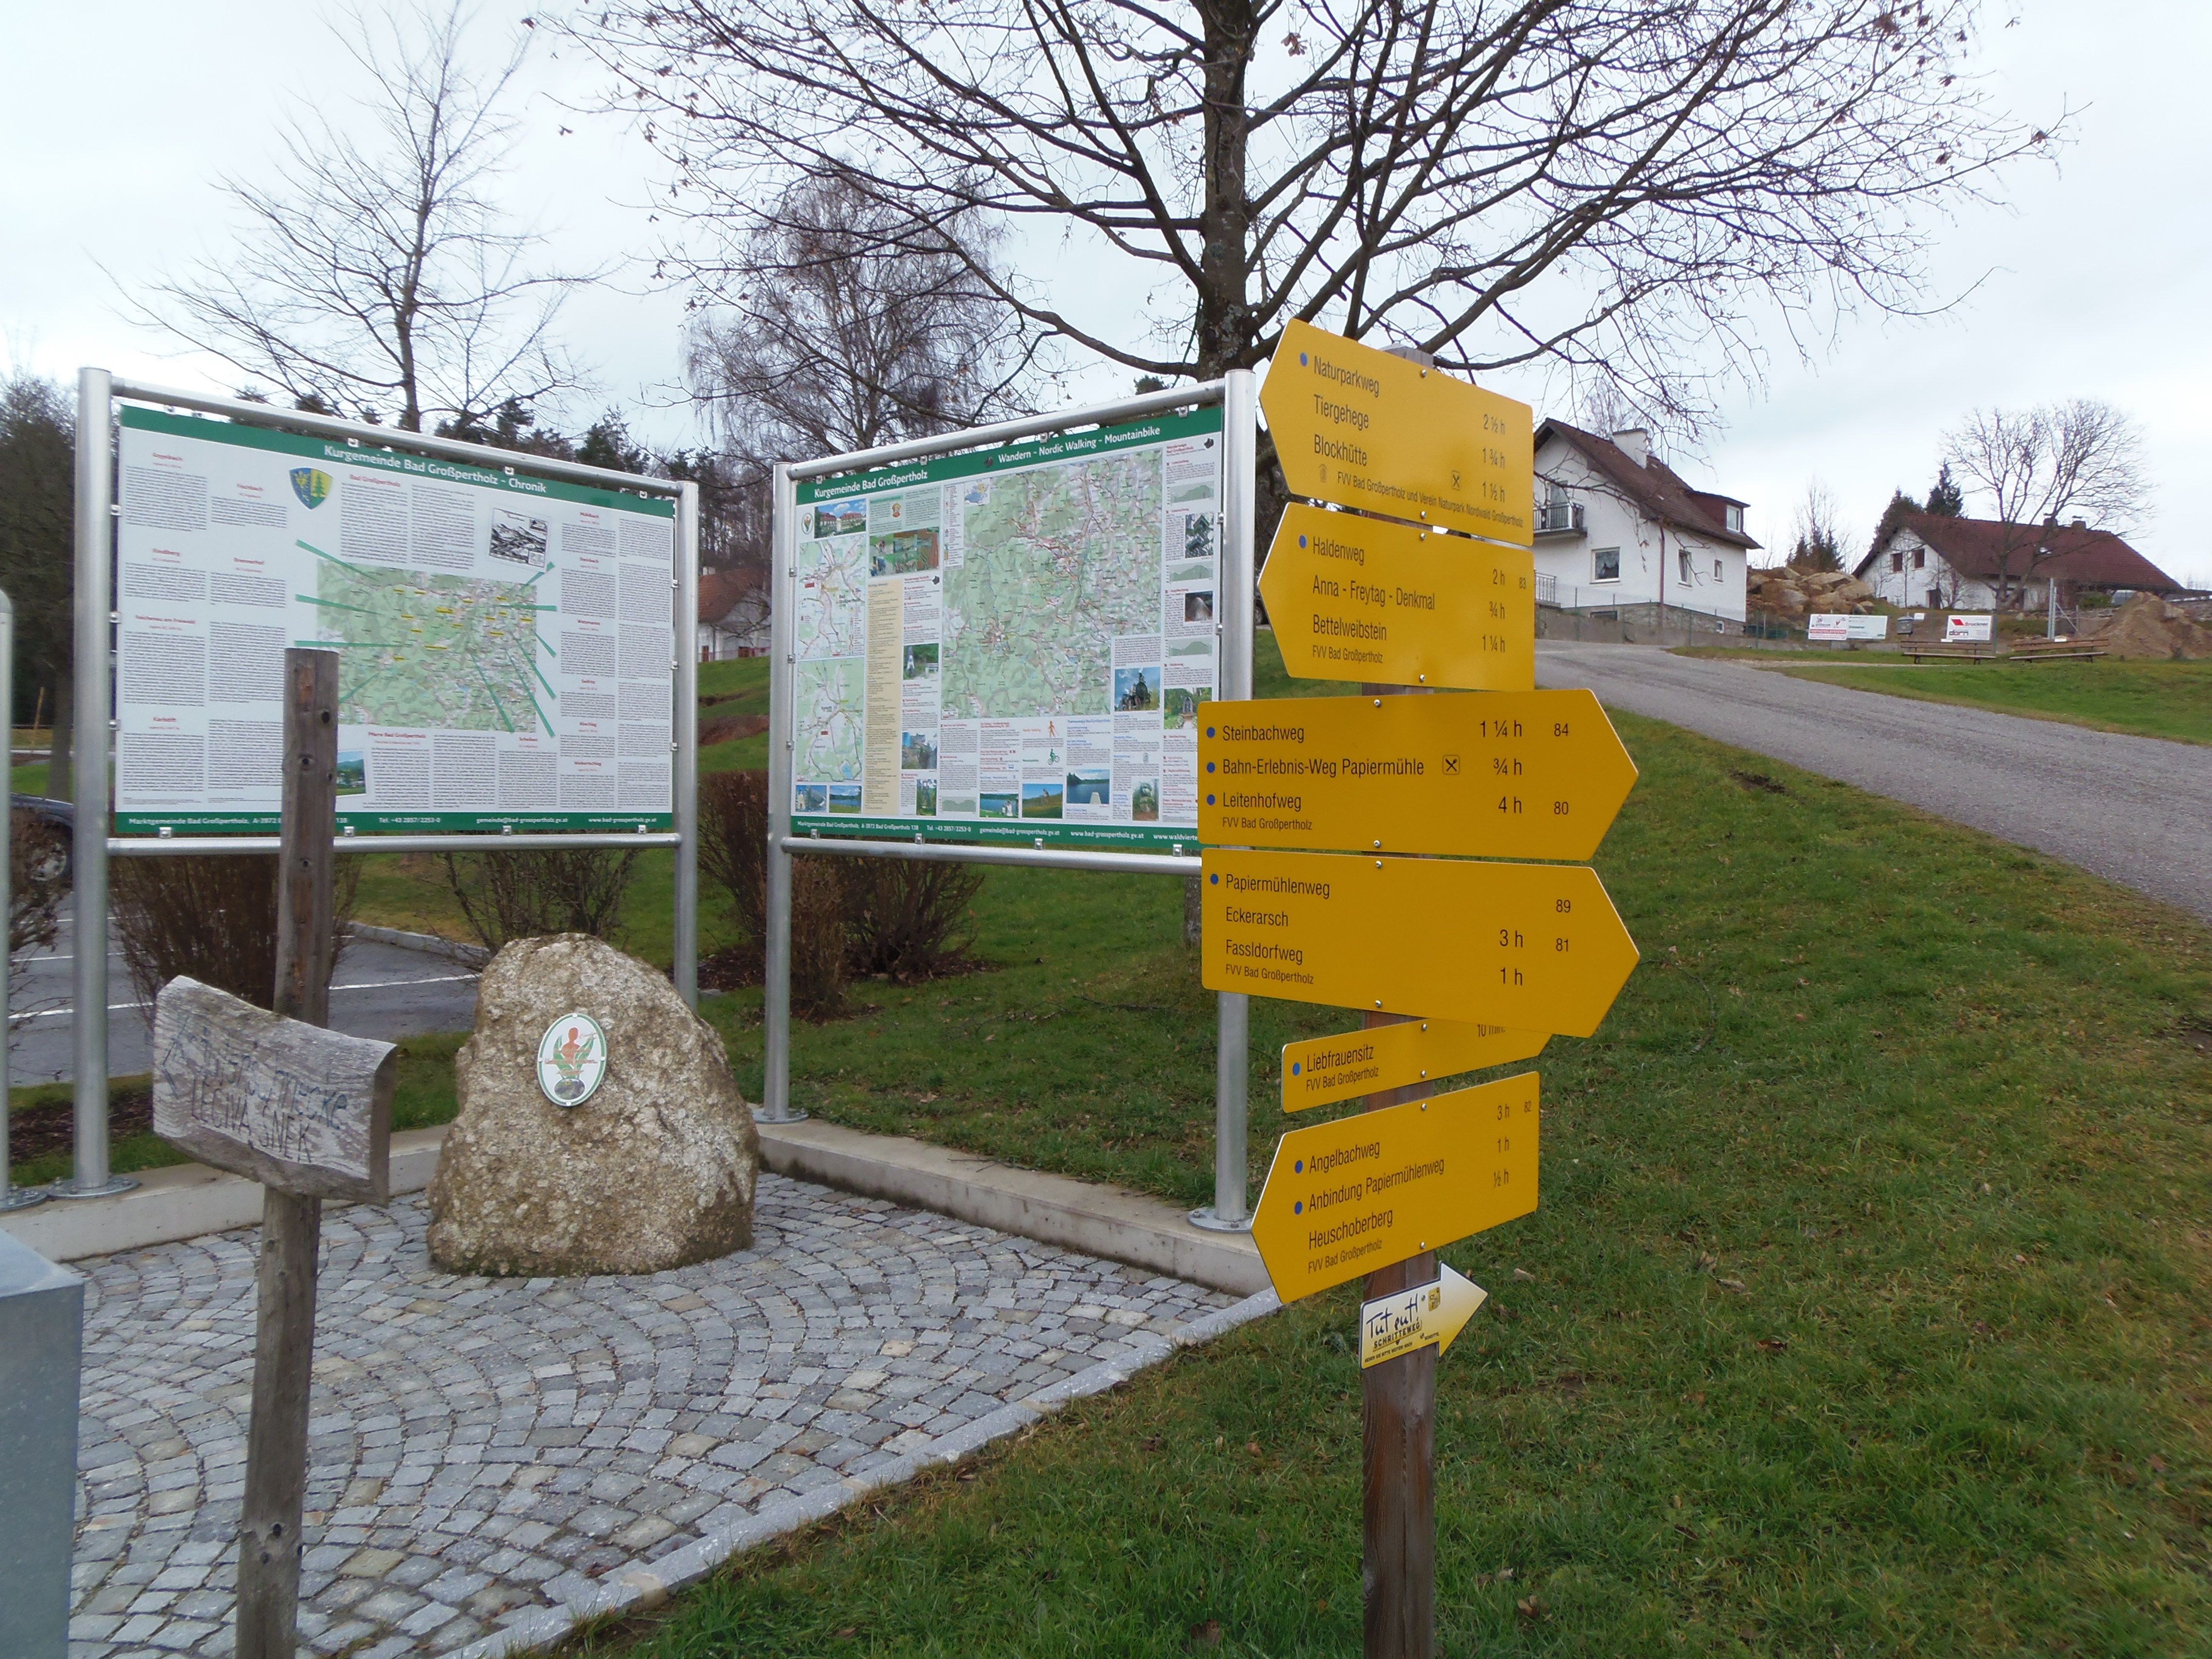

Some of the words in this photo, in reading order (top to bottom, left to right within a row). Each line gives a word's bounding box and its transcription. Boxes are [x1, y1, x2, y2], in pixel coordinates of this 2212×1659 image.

[1314, 356, 1379, 397] Naturparkweg
[1313, 394, 1369, 431] Tiergehege
[1484, 414, 1488, 430] 2
[1501, 420, 1505, 435] h
[998, 450, 1031, 464] Wandern
[1038, 443, 1064, 456] Nordic
[1065, 438, 1097, 450] Walking
[1104, 427, 1160, 445] Mountainbike
[1314, 434, 1367, 466] Blockhütte
[1483, 447, 1486, 463] 1
[1500, 452, 1505, 469] h
[324, 445, 401, 468] Kurgemeinde
[404, 459, 425, 472] Bad
[428, 463, 498, 484] Großpertholz
[509, 477, 546, 493] Chronik
[814, 481, 860, 499] Kurgemeinde
[862, 477, 876, 490] Bad
[877, 469, 928, 487] Großpertholz
[1338, 471, 1351, 485] FVV
[1353, 476, 1365, 489] Bad
[1367, 479, 1405, 499] Großpertholz
[1407, 491, 1418, 502] und
[1419, 493, 1436, 506] Verein
[1438, 497, 1465, 513] Naturpark
[1482, 481, 1486, 497] 1
[1500, 485, 1505, 503] h
[1313, 536, 1364, 566] Haldenweg
[1493, 568, 1498, 584] 2
[1500, 570, 1505, 585] h
[1519, 577, 1526, 590] 83
[1312, 575, 1339, 597] Anna
[1350, 580, 1386, 608] Freytag
[1396, 587, 1435, 610] Denkmal
[1500, 603, 1505, 619] h
[1313, 614, 1387, 641] Bettelweibstein
[1482, 635, 1486, 651] 1
[1500, 637, 1505, 653] h
[1312, 645, 1326, 658] FVV
[1328, 646, 1341, 660] Bad
[1343, 648, 1383, 664] Großpertholz
[1223, 725, 1305, 743] Steinbachweg
[1480, 721, 1486, 738] 1
[1514, 720, 1522, 737] h
[1554, 723, 1569, 737] 84
[1223, 758, 1337, 778] Bahn-Erlebnis-Weg
[1342, 758, 1424, 778] Papiermühle
[1514, 758, 1522, 775] h
[1223, 792, 1302, 812] Leitenhofweg
[1498, 796, 1507, 814] 4
[1514, 796, 1522, 814] h
[1554, 801, 1569, 815] 80
[1222, 817, 1239, 827] FVV
[1242, 818, 1256, 828] Bad
[1259, 818, 1312, 831] Großpertholz
[1226, 873, 1330, 899] Papiermühlenweg
[1556, 899, 1571, 913] 89
[1226, 906, 1288, 926] Eckerarsch
[1500, 929, 1508, 947] 3
[1515, 930, 1523, 948] h
[1556, 938, 1569, 952] 81
[1225, 964, 1242, 975] FVV
[1244, 966, 1259, 978] Bad
[1261, 968, 1314, 985] Großpertholz
[1226, 939, 1303, 965] Fassldorfweg
[1500, 967, 1506, 984] 1
[1515, 968, 1523, 986] h
[1307, 1044, 1374, 1072] Liebfrauensitz
[1306, 1078, 1321, 1092] FVV
[1323, 1074, 1336, 1088] Bad
[1338, 1066, 1379, 1085] Großpertholz
[1498, 1105, 1502, 1120] 3
[1505, 1103, 1510, 1118] h
[1524, 1100, 1532, 1113] 82
[1309, 1142, 1380, 1174] Angelbachweg
[1498, 1138, 1501, 1153] 1
[1505, 1136, 1509, 1151] h
[1309, 1184, 1362, 1212] Anbindung
[1365, 1159, 1445, 1195] Papiermühlenweg
[1504, 1168, 1509, 1184] h
[1309, 1210, 1393, 1250] Heuschoberberg
[1308, 1260, 1323, 1274] FVV
[1325, 1255, 1338, 1271] Bad
[1340, 1238, 1382, 1263] Großpertholz
[1366, 1307, 1393, 1339] Tut
[1373, 1321, 1421, 1349] SCHRITTEWEG
